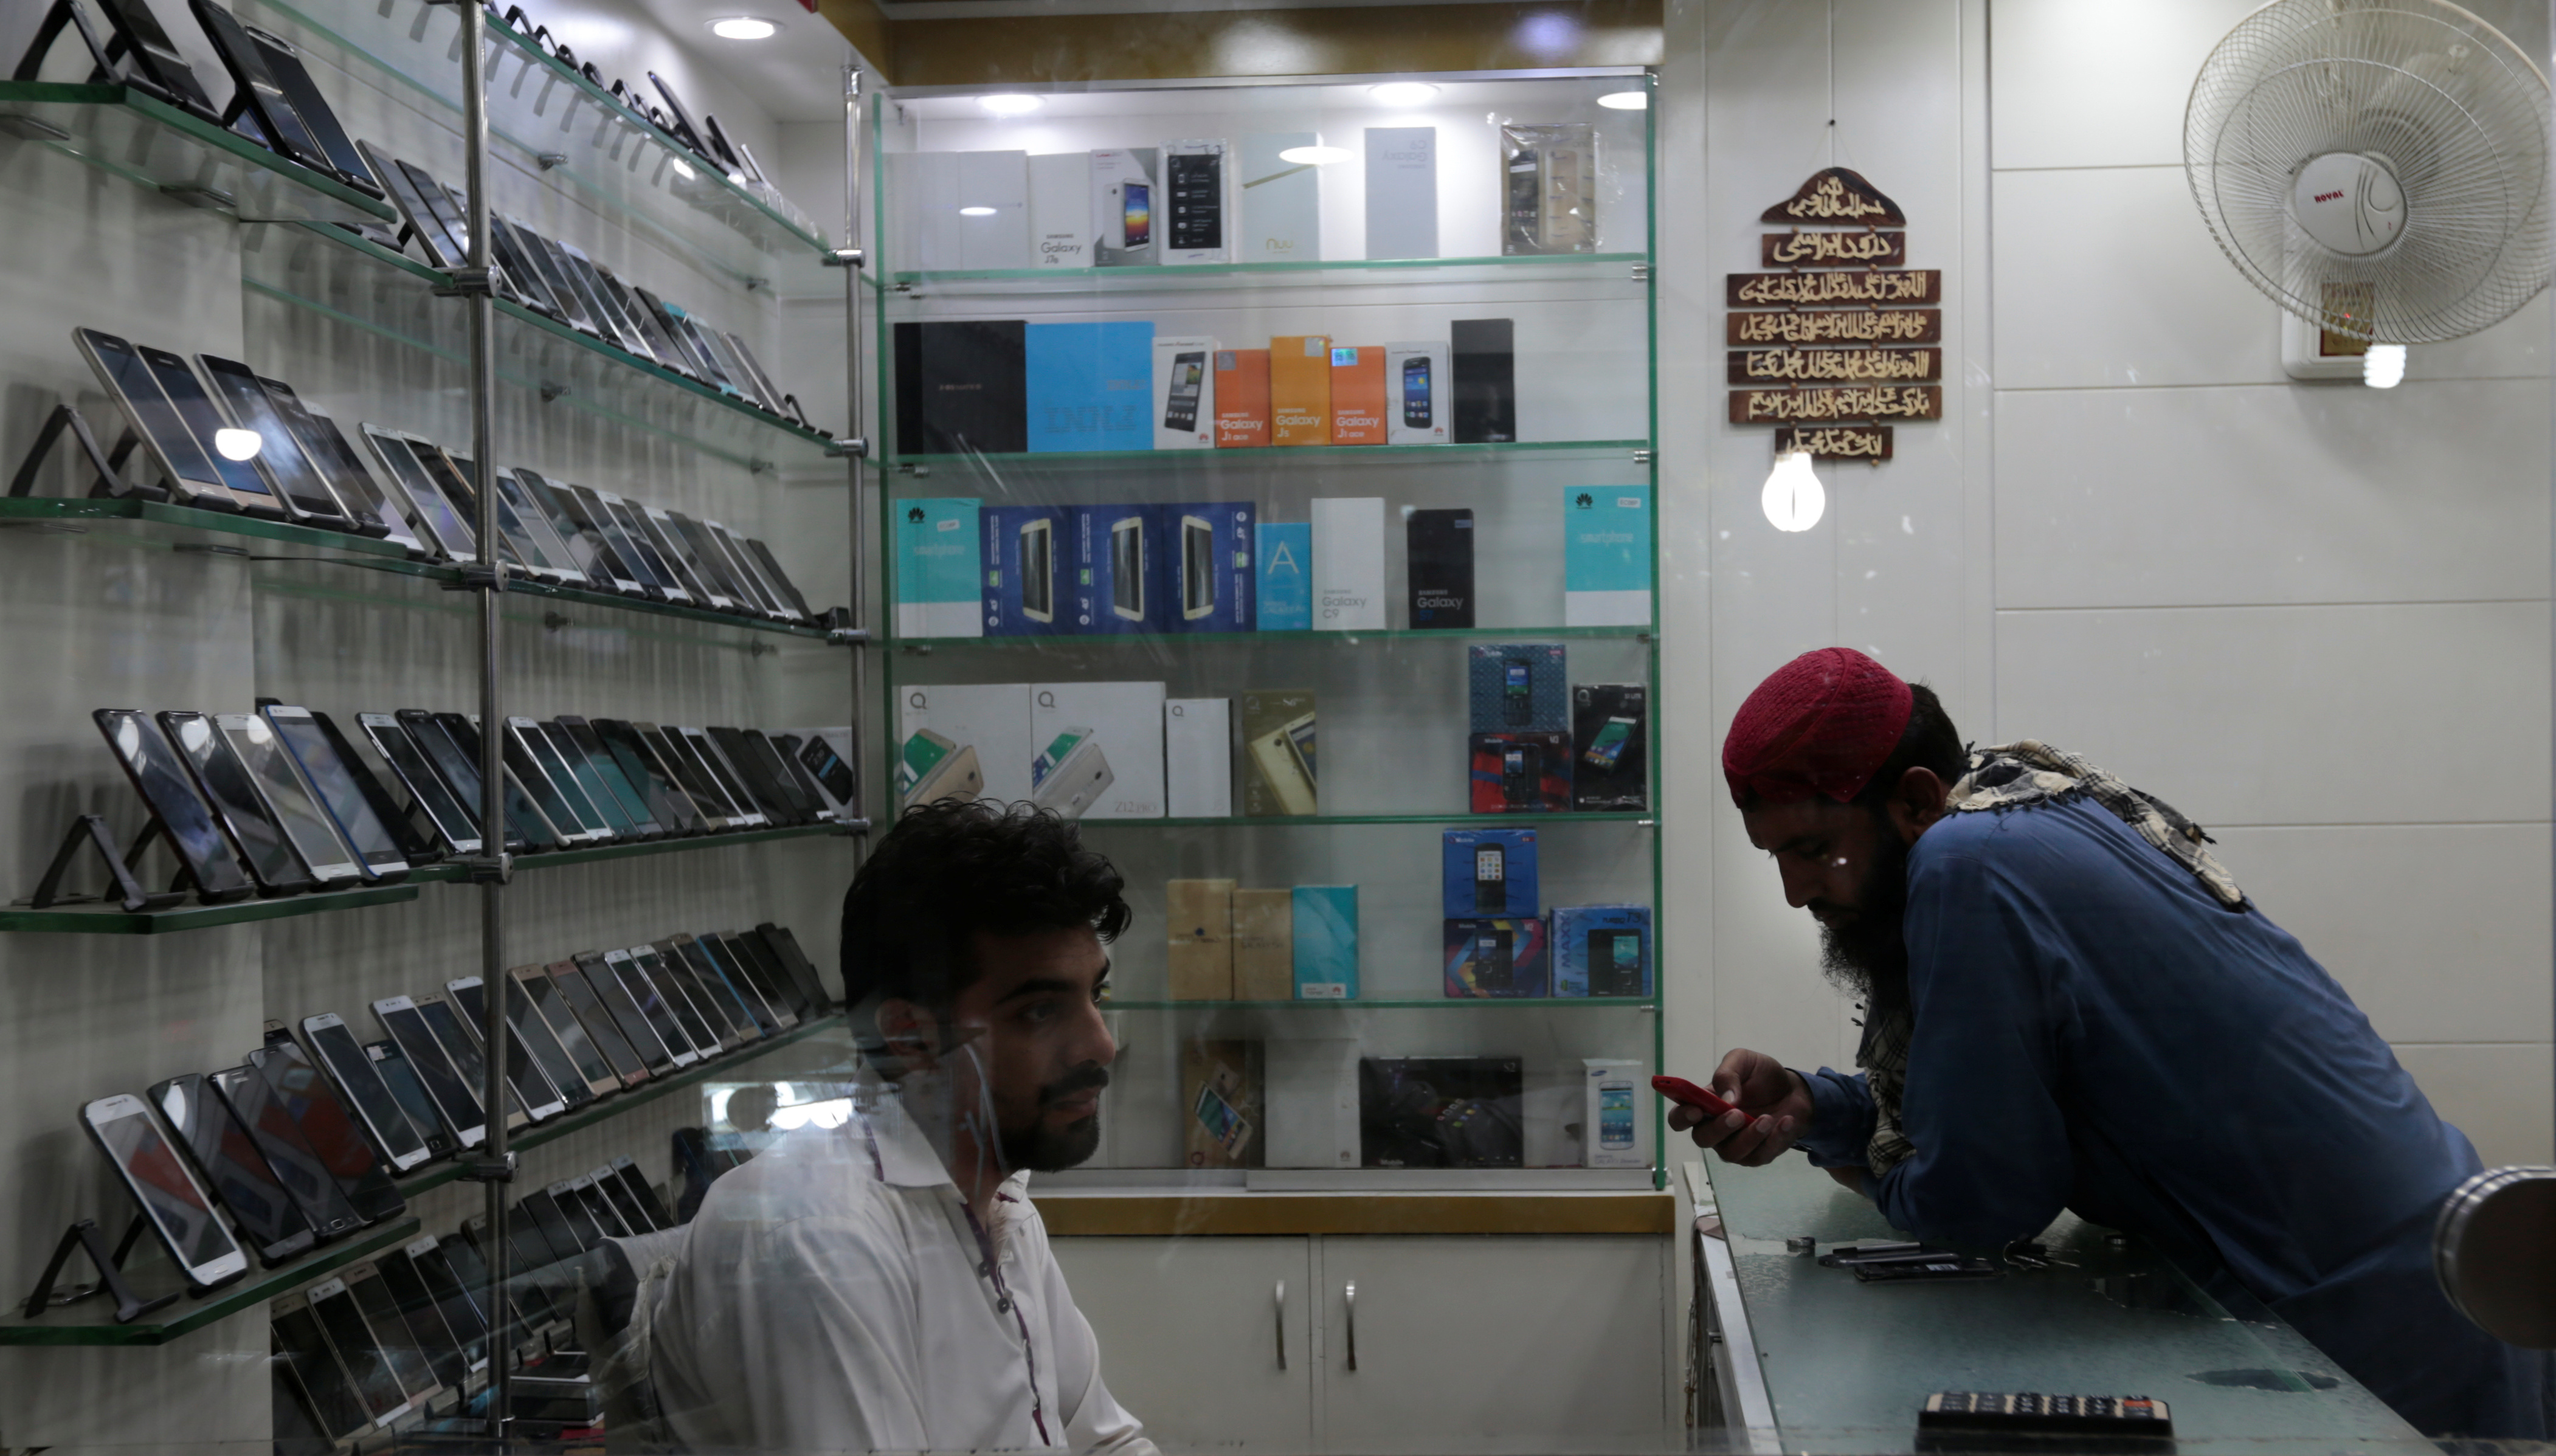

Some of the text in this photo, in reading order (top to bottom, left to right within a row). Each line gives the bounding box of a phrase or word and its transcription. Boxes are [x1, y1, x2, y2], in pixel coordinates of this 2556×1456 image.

[2314, 189, 2344, 203] ROYAL
[1040, 241, 1082, 254] Galaxy
[1220, 419, 1263, 430] Galaxy
[1276, 415, 1321, 427] Galaxy
[1336, 417, 1380, 427] Galaxy
[1268, 540, 1299, 574] A
[1322, 597, 1367, 609] Galaxy
[1417, 597, 1464, 610] Galaxy
[1322, 609, 1339, 619] C9
